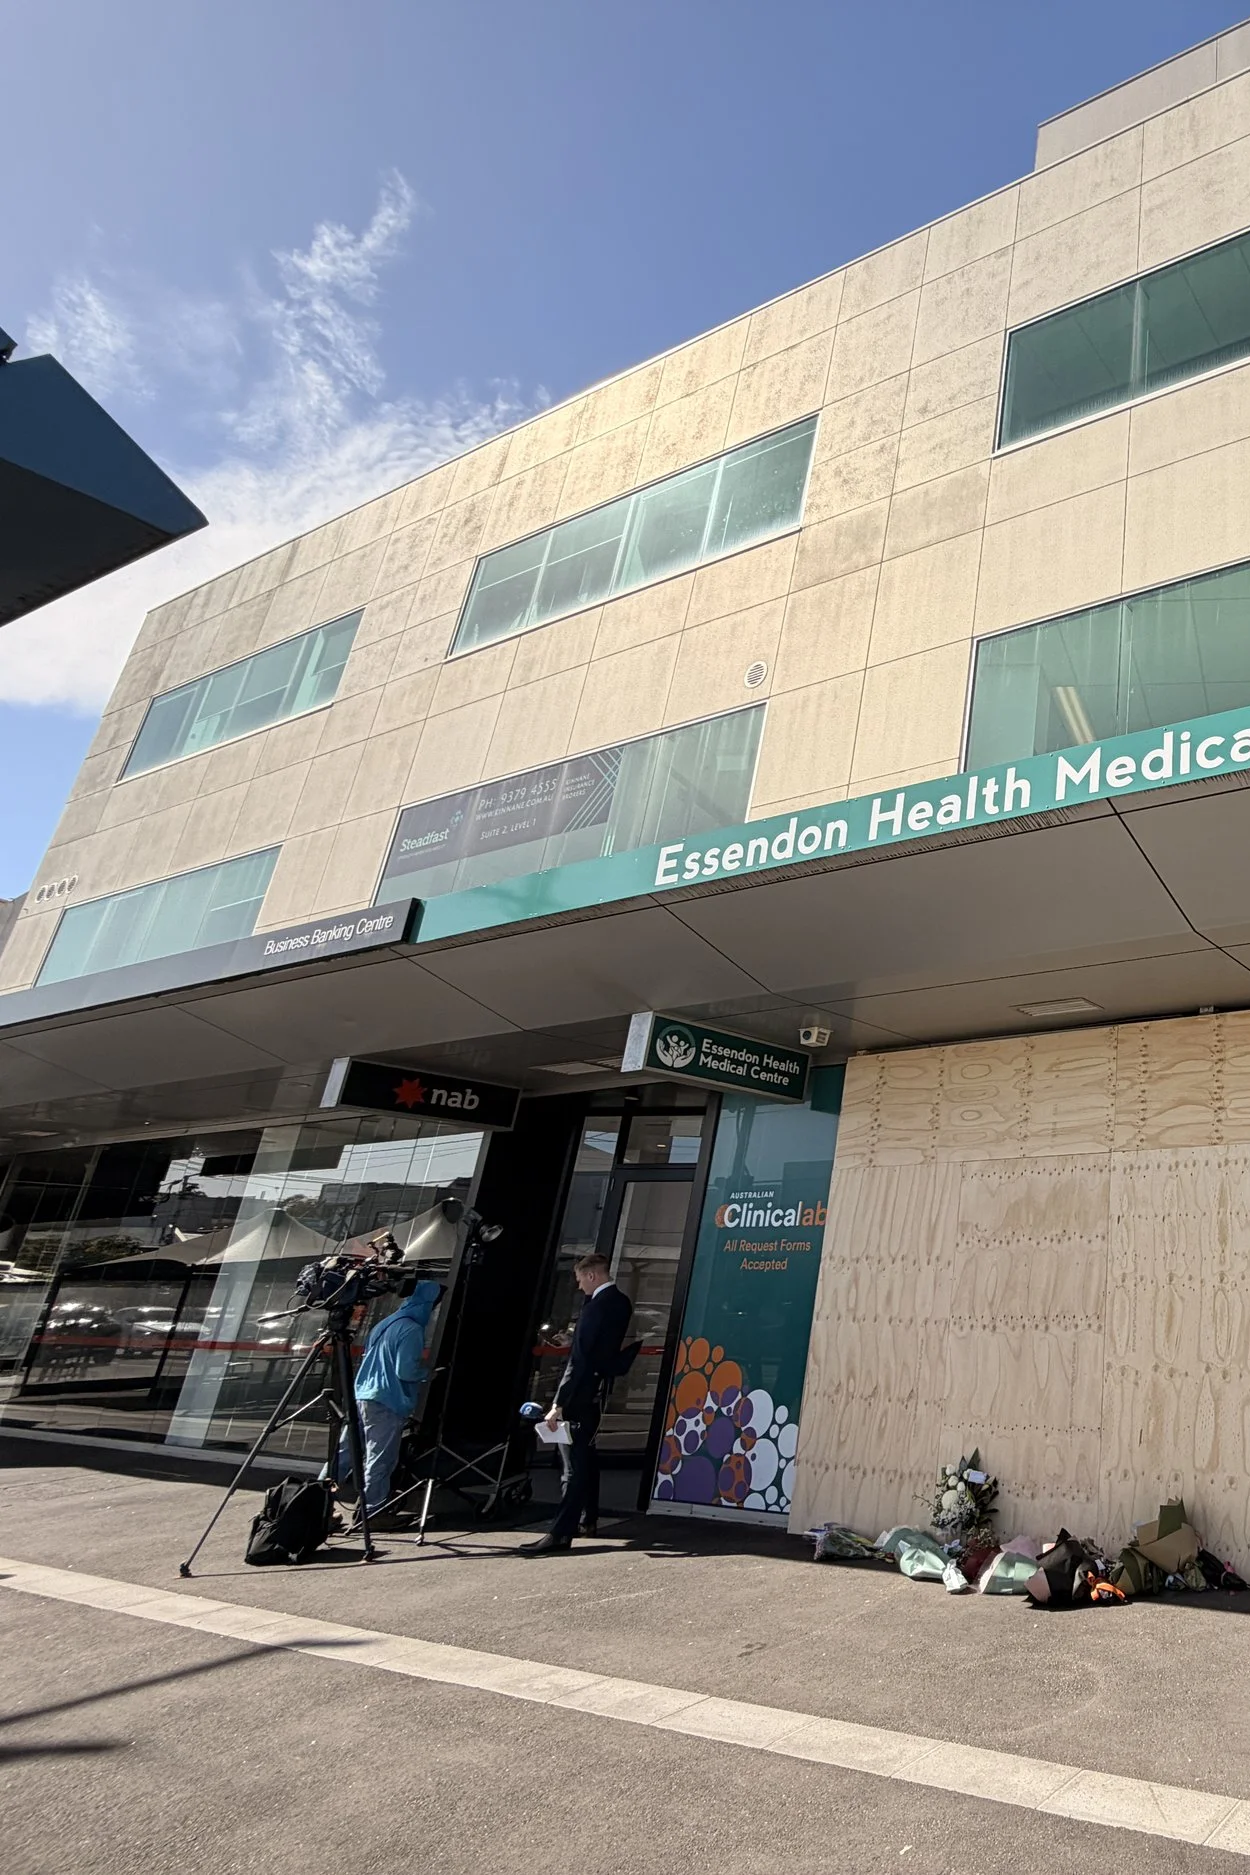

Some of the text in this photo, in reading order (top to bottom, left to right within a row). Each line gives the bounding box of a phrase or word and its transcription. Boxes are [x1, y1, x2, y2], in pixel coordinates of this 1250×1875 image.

[501, 787, 527, 805] 9379
[531, 778, 557, 796] 4555
[480, 828, 500, 840] SUITE
[510, 820, 530, 832] LEVEL
[532, 817, 537, 826] 1
[653, 818, 848, 887] Essendon
[868, 766, 1031, 841] Health
[400, 828, 450, 851] Steadfast
[264, 915, 394, 955] Business Banking Centre
[701, 1038, 800, 1075] Essendon Health
[699, 1053, 790, 1086] Medical Centre
[430, 1088, 480, 1110] nab
[730, 1191, 775, 1200] AUSTRALIAN
[723, 1239, 812, 1254] All Request Forms
[740, 1257, 788, 1272] Accepted
